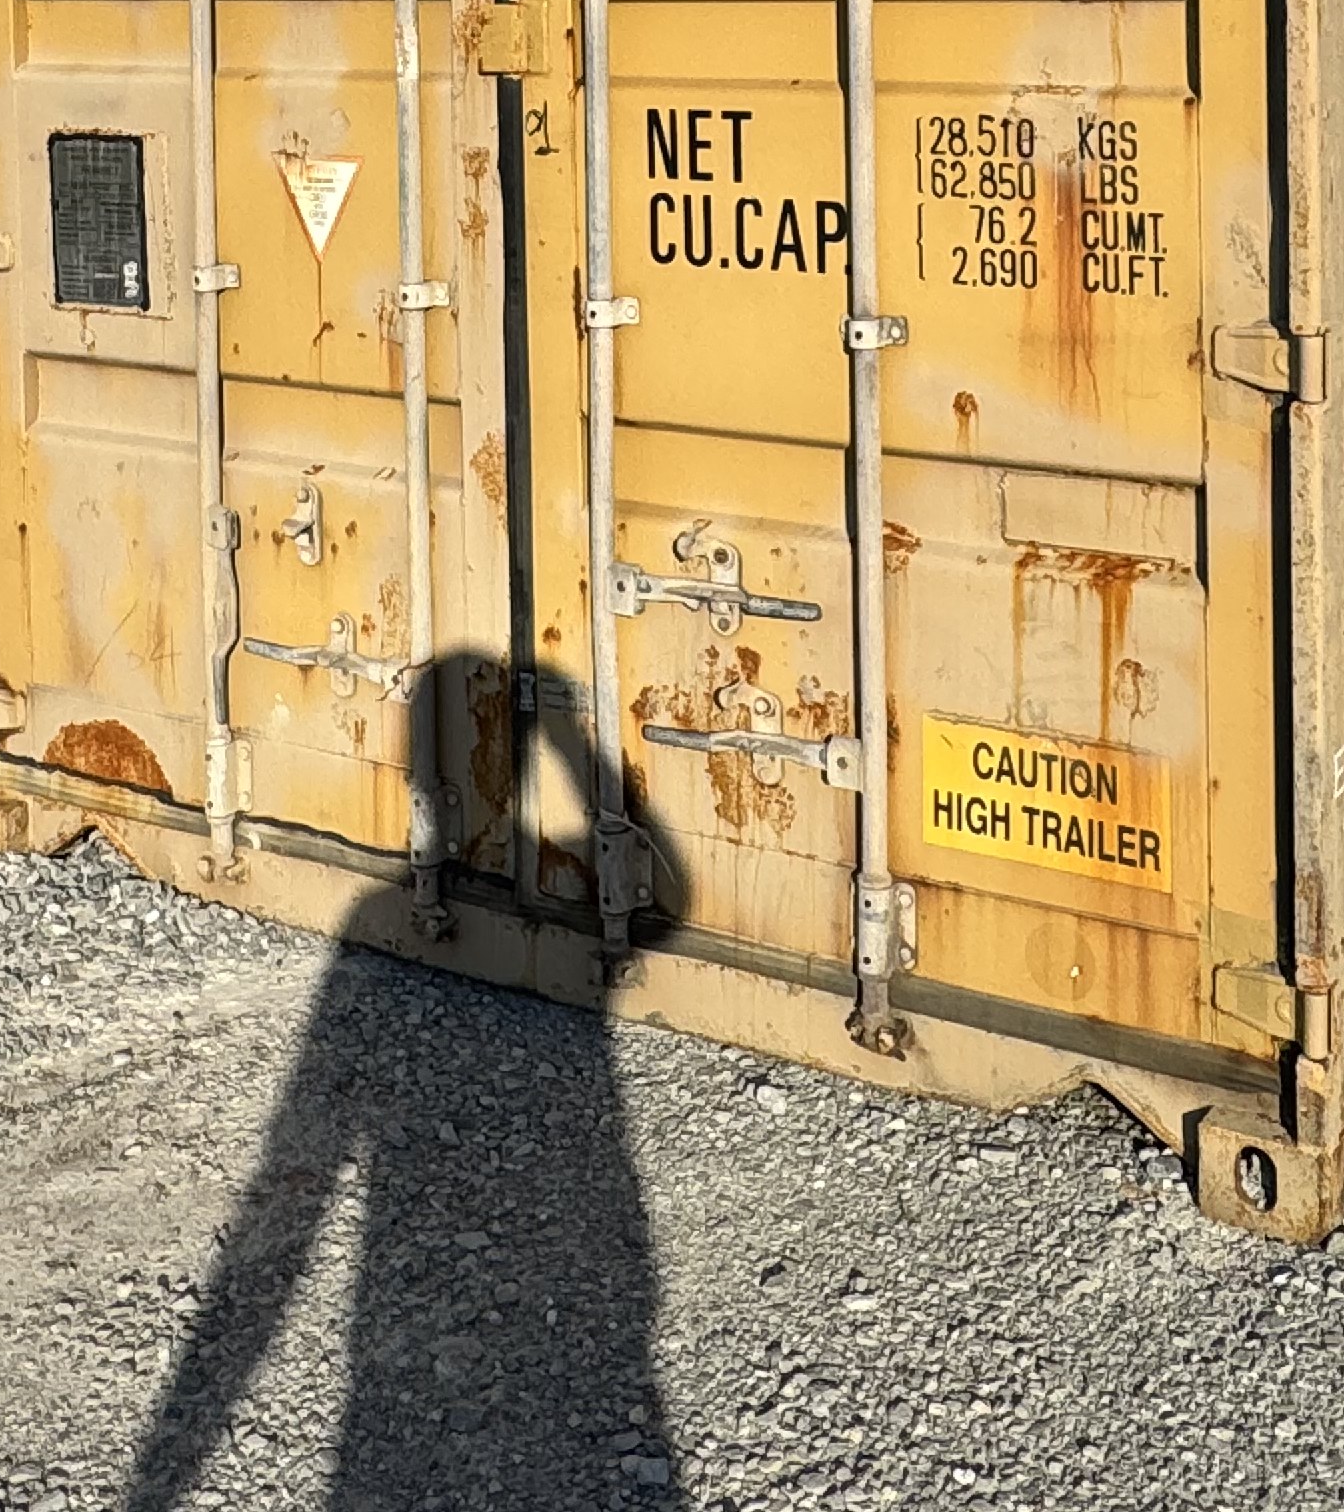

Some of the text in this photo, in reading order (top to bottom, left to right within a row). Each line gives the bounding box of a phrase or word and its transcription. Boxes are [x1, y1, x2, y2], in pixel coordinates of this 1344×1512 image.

[646, 108, 753, 184] NET
[1077, 116, 1139, 162] KGS
[1079, 163, 1139, 206] LBS
[1081, 251, 1169, 298] CU.FT.
[972, 741, 1118, 806] CAUTION
[933, 788, 1161, 872] HIGH TRAILER
